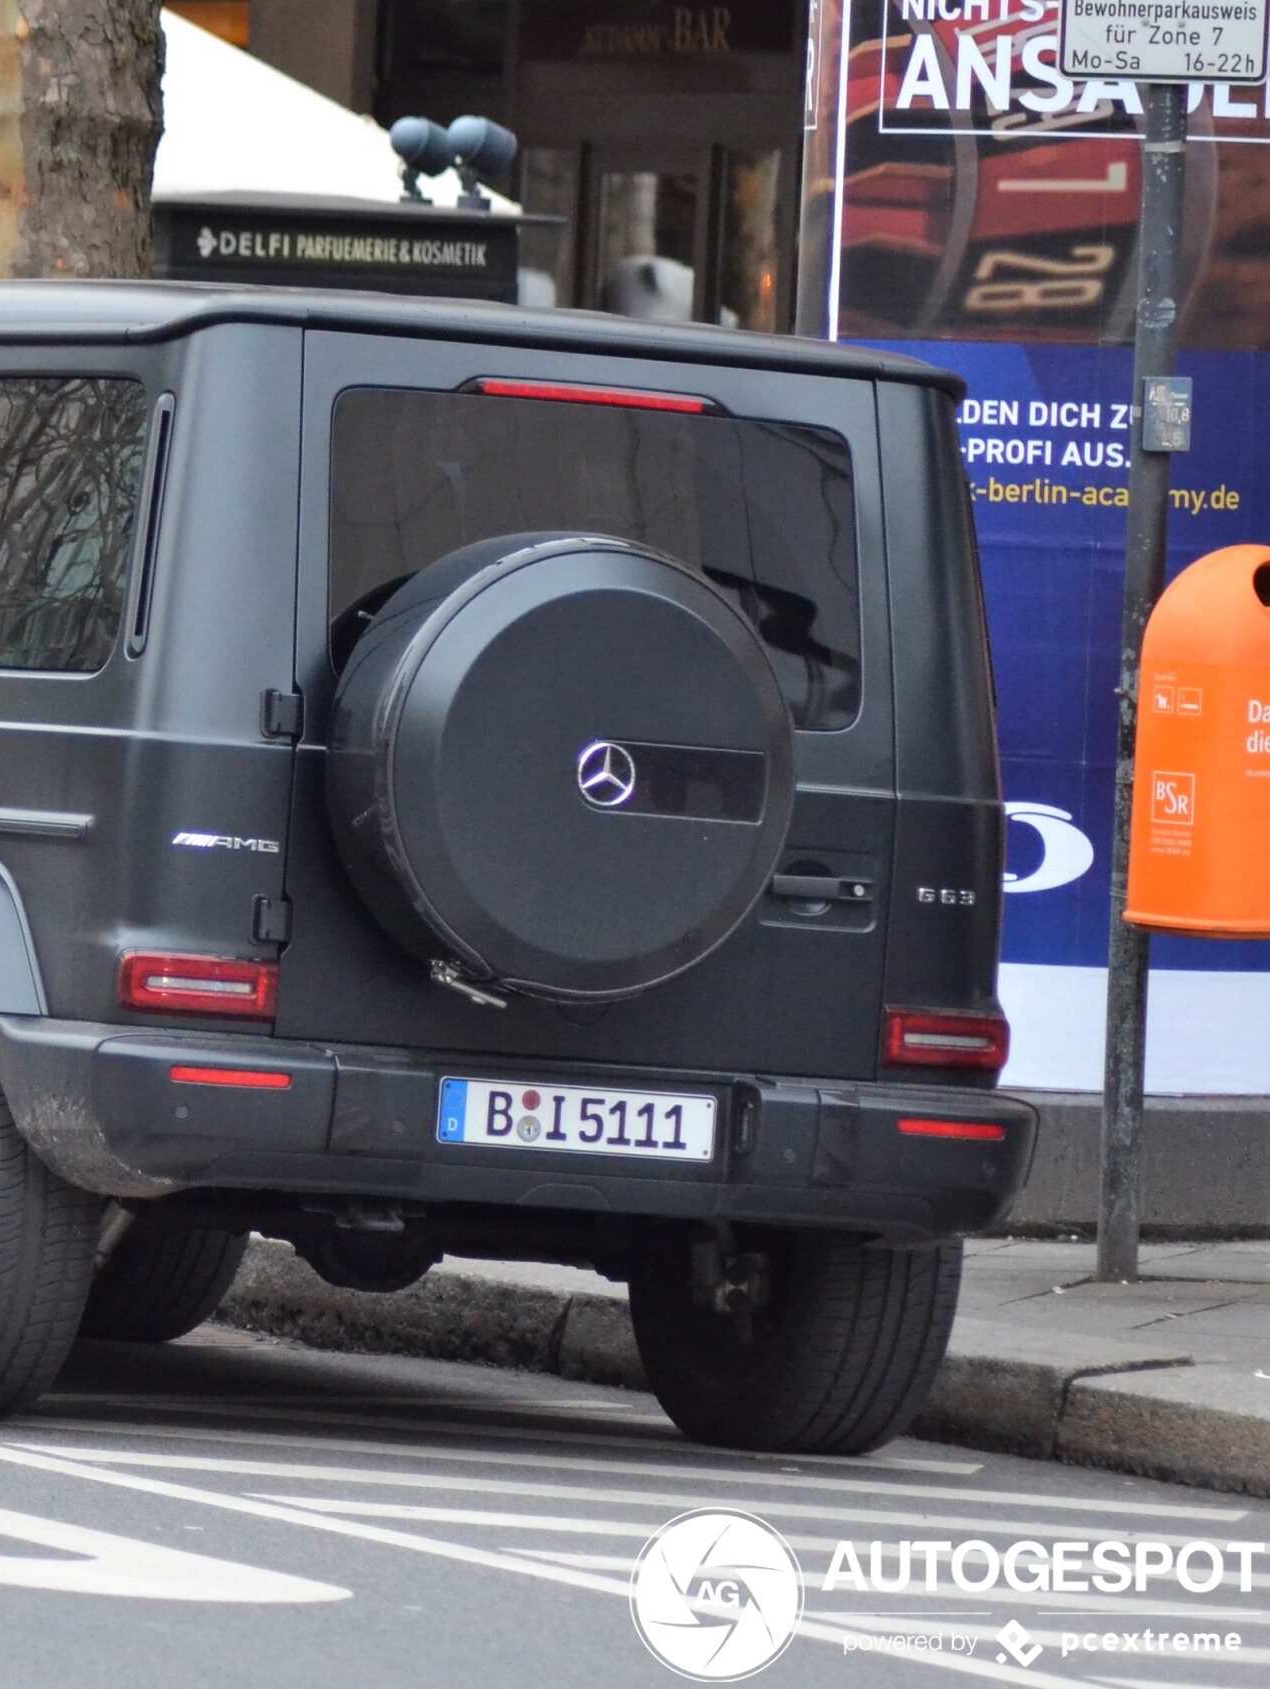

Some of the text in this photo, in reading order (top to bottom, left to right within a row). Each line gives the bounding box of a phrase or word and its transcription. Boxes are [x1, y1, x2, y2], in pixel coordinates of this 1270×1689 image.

[1075, 0, 1257, 23] Bewohnerparkausweis
[1106, 25, 1224, 46] für Zone 7
[1072, 50, 1141, 71] Mo-Sa
[219, 231, 290, 258] DELFI
[956, 399, 1133, 429] DEN DICH Z
[1061, 442, 1131, 468] AUS.
[1156, 780, 1189, 815] BSR
[208, 835, 279, 853] AMG
[447, 1117, 458, 1131] D
